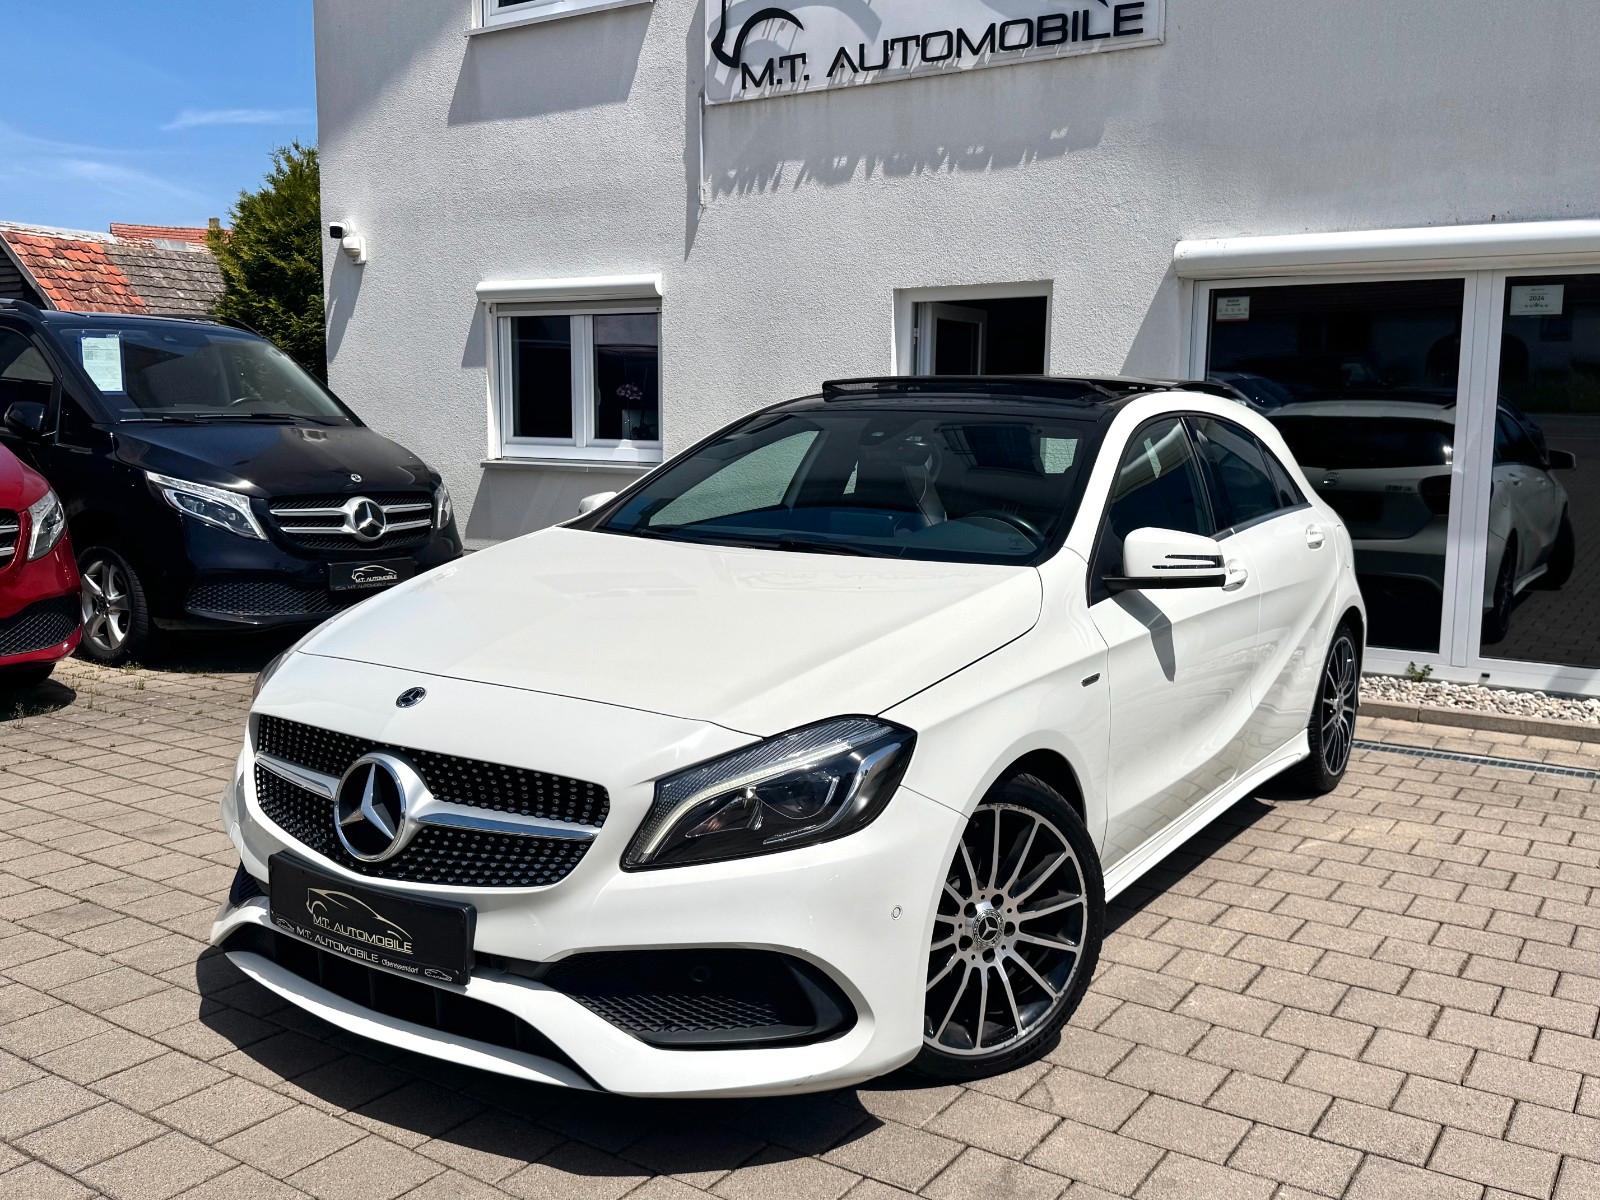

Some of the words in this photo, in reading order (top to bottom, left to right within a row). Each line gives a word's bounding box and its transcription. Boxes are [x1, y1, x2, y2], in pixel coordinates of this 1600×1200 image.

[741, 53, 810, 90] M.T.
[826, 1, 1145, 78] AUTOMOBILE
[366, 574, 398, 582] AUTOMOBILE
[296, 926, 313, 940] M.T.
[314, 934, 379, 963] AUTOMOBILE
[313, 914, 331, 930] M.T.
[333, 922, 413, 952] AUTOMOBILE
